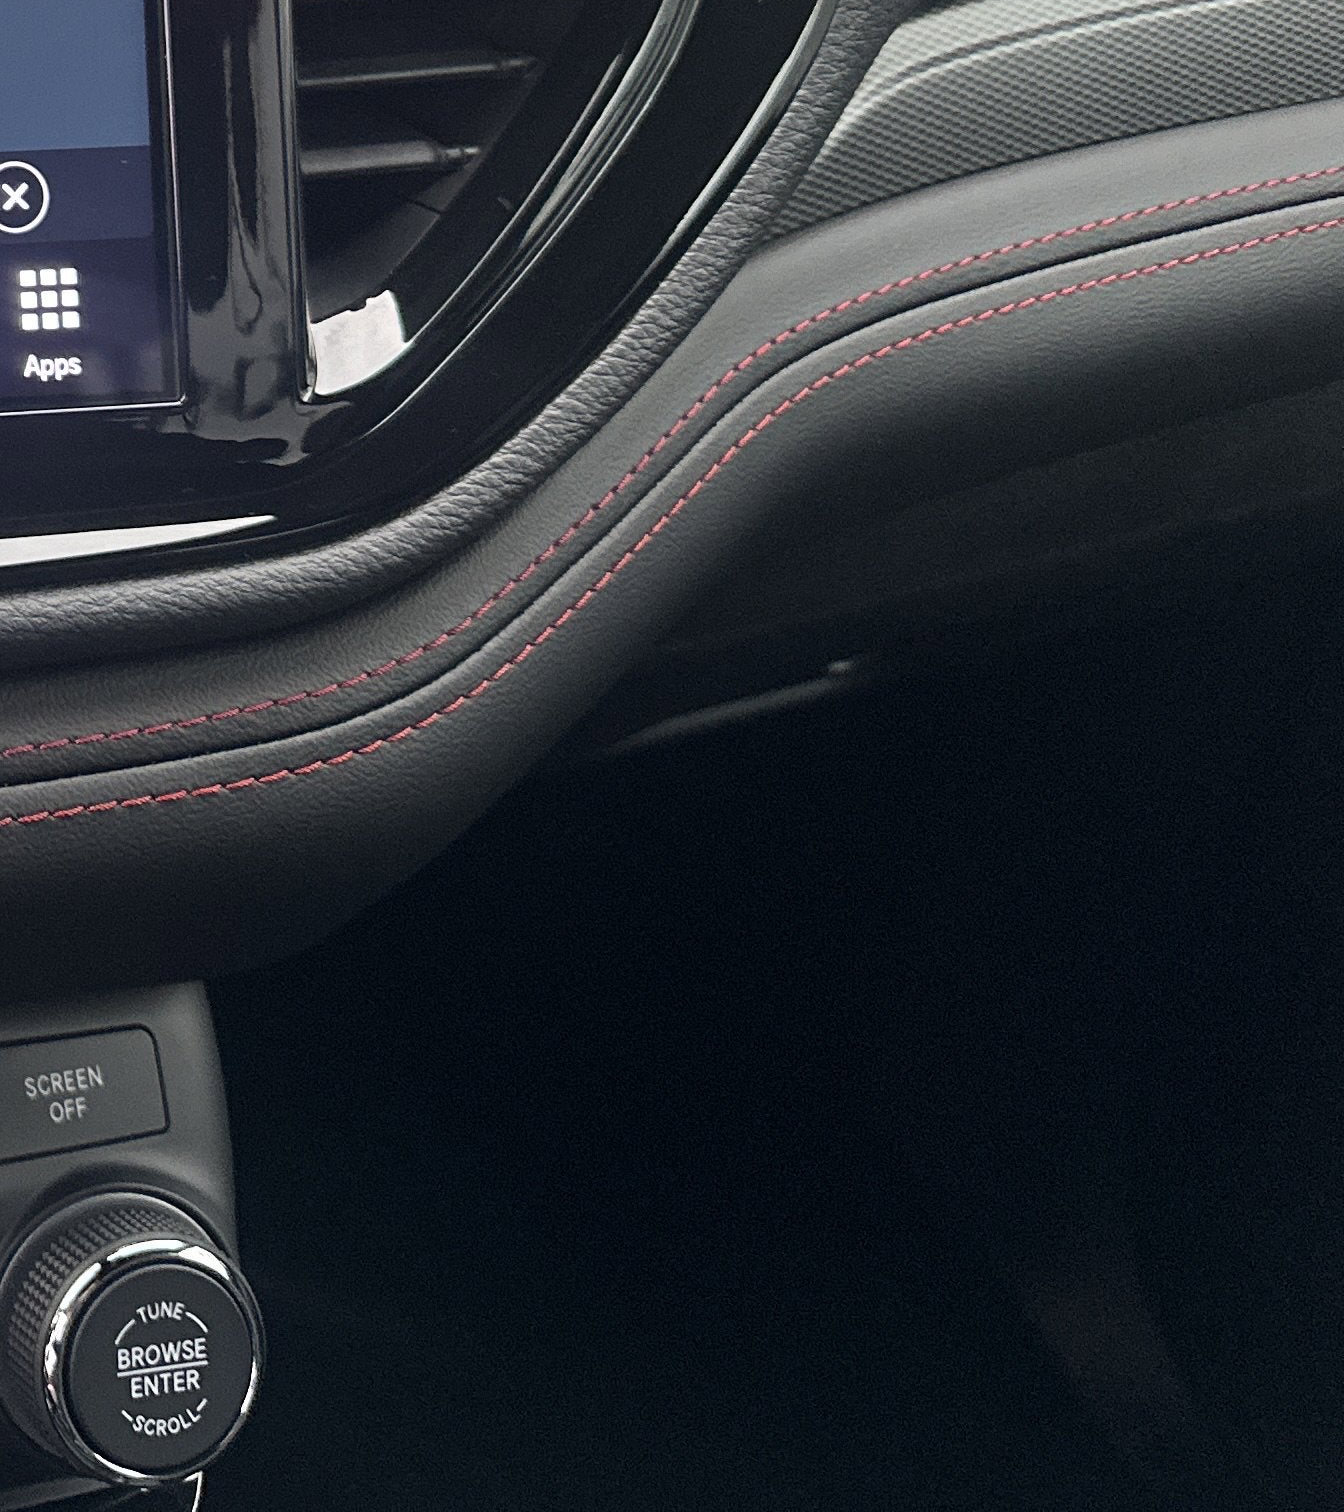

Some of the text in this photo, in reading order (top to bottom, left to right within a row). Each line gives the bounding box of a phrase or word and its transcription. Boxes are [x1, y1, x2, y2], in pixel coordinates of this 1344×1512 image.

[23, 350, 83, 382] Apps
[24, 1065, 104, 1100] SCREEN
[49, 1096, 87, 1124] OFF
[136, 1300, 186, 1324] TUNE
[117, 1337, 208, 1370] BROWSE
[131, 1369, 201, 1399] ENTER
[132, 1409, 202, 1438] SCROLL
